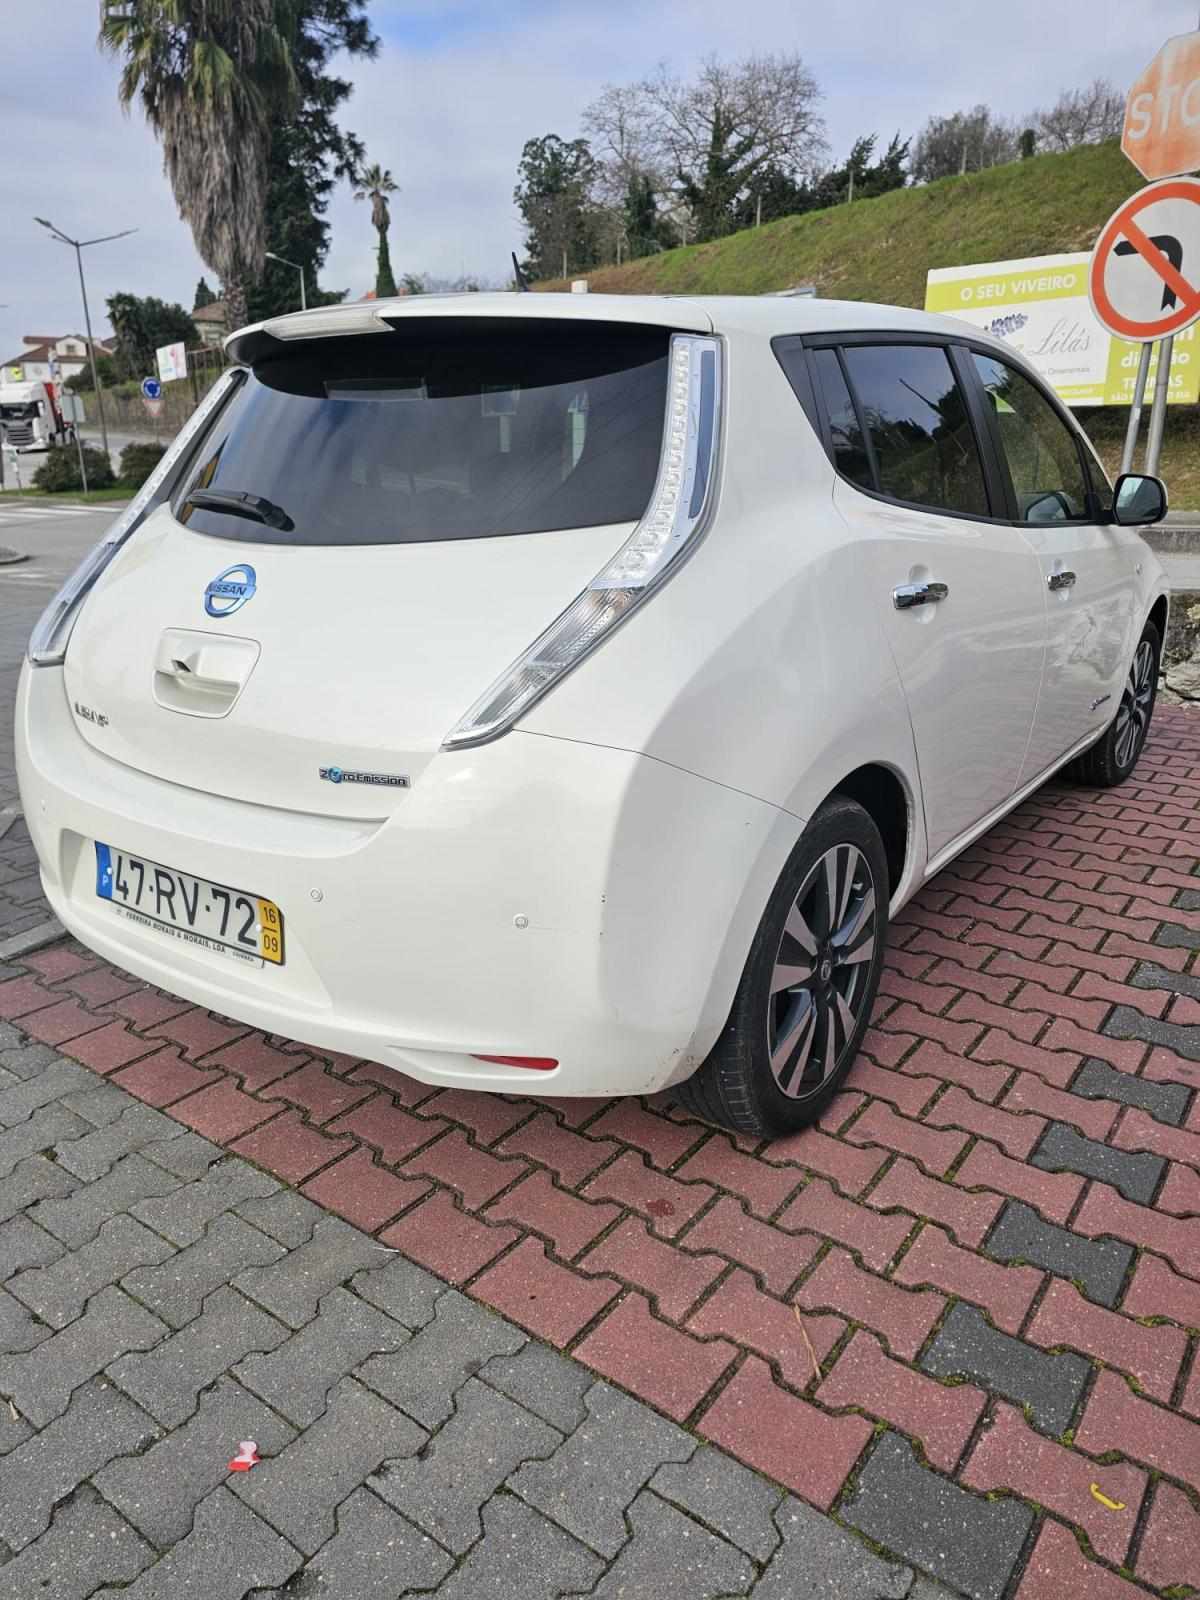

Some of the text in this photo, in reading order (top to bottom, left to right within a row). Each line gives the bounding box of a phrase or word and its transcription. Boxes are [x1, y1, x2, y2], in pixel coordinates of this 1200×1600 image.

[960, 273, 1077, 301] O SEU VIVEIRO
[102, 874, 110, 887] P
[263, 906, 277, 925] 16
[263, 934, 279, 953] 09
